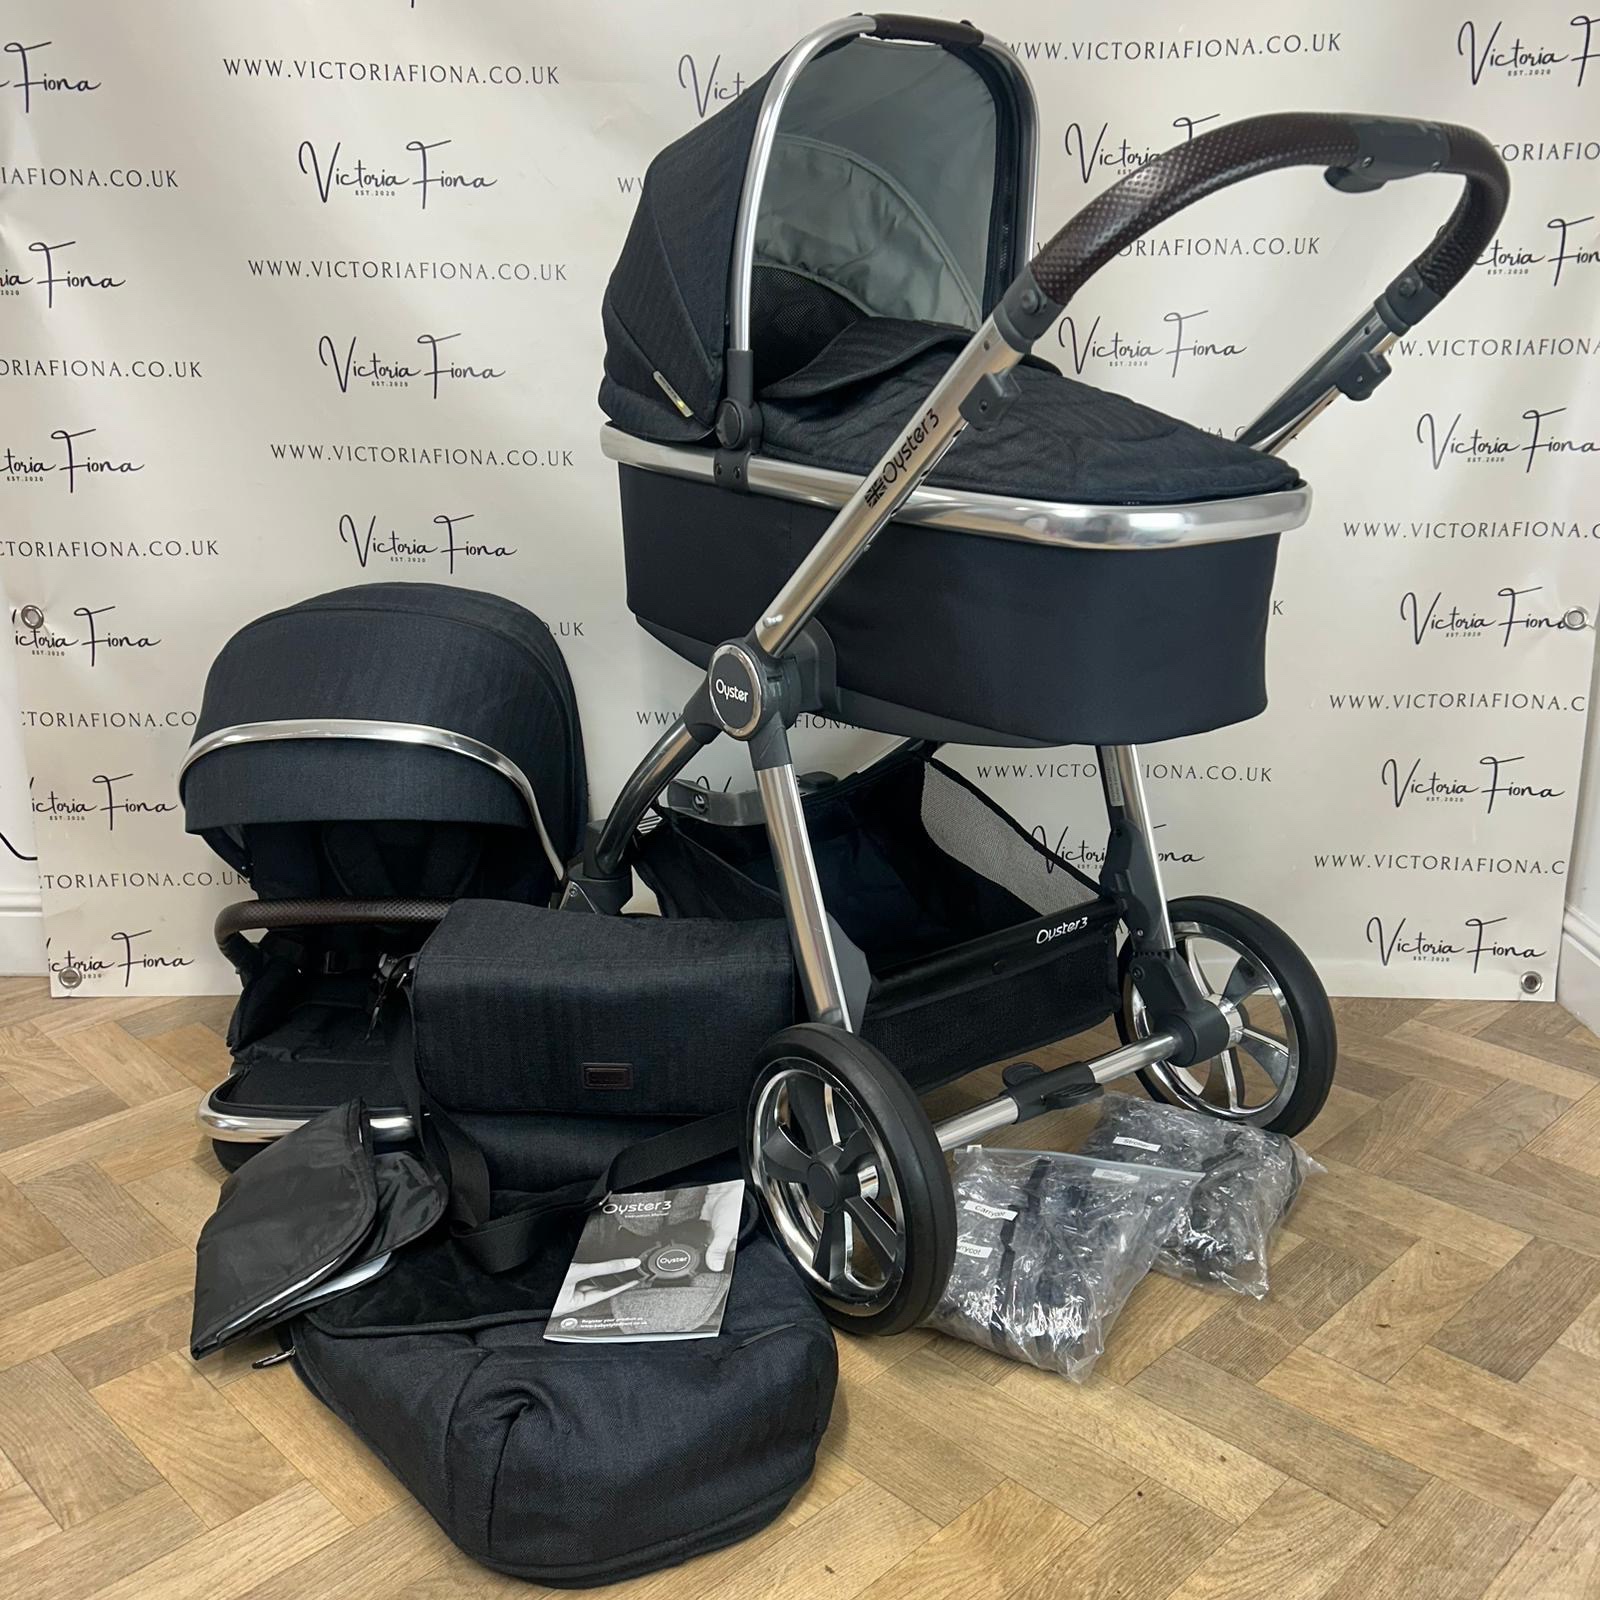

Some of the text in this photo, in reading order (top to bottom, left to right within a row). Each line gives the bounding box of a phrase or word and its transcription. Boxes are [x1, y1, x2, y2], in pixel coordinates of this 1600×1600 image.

[4, 42, 101, 113] Fiona
[223, 59, 559, 85] WWW.VICTORIAFIONA.CO.UK
[1458, 21, 1568, 85] Victoria
[678, 54, 745, 118] Vict
[298, 140, 497, 209] Victoria Fiona
[28, 241, 126, 308] Fiona
[248, 260, 567, 281] WWW.VICTORIAFIONA.CO.UK
[319, 333, 506, 399] Victoria Fiona
[1058, 310, 1247, 378] Victoria Fiona
[51, 428, 145, 493] Fiona
[270, 444, 574, 467] WWW.VICTORIAFIONA.CO.UK
[1417, 407, 1600, 473] Victoria Fiona
[339, 514, 517, 574] Victoria Fiona
[12, 606, 161, 667] ictoria Fiona
[1400, 592, 1496, 645] Victoria
[715, 678, 749, 703] Oyster
[30, 773, 177, 831] ictoria Fiona
[1381, 756, 1566, 814] Victoria Fiona
[1032, 825, 1106, 875] Victori
[111, 930, 194, 987] Fiona
[1366, 917, 1546, 974] Victoria Fiona
